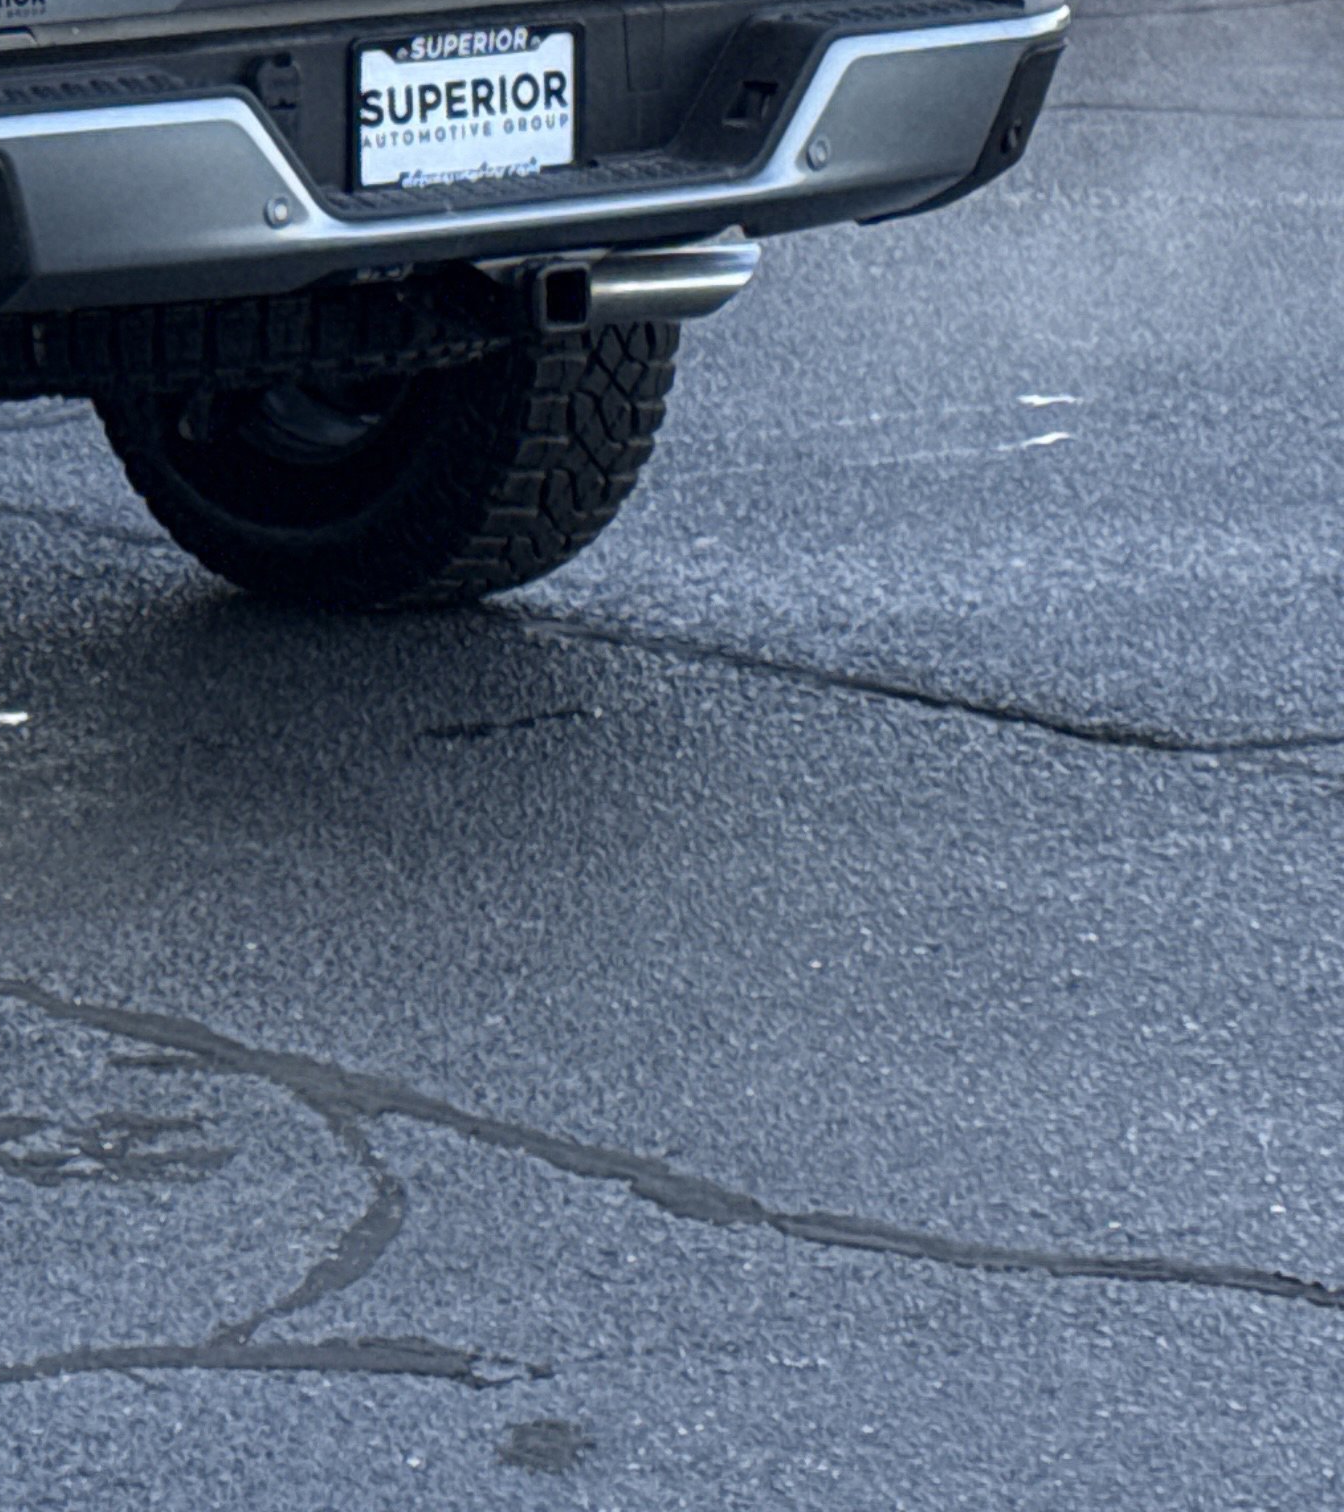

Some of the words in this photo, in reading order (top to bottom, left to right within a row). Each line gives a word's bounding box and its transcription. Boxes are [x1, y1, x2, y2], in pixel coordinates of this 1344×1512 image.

[410, 26, 528, 60] SUPERIOR
[360, 70, 568, 128] SUPERIOR
[361, 120, 492, 149] AUTOMOTIVE
[502, 113, 569, 134] GROUP
